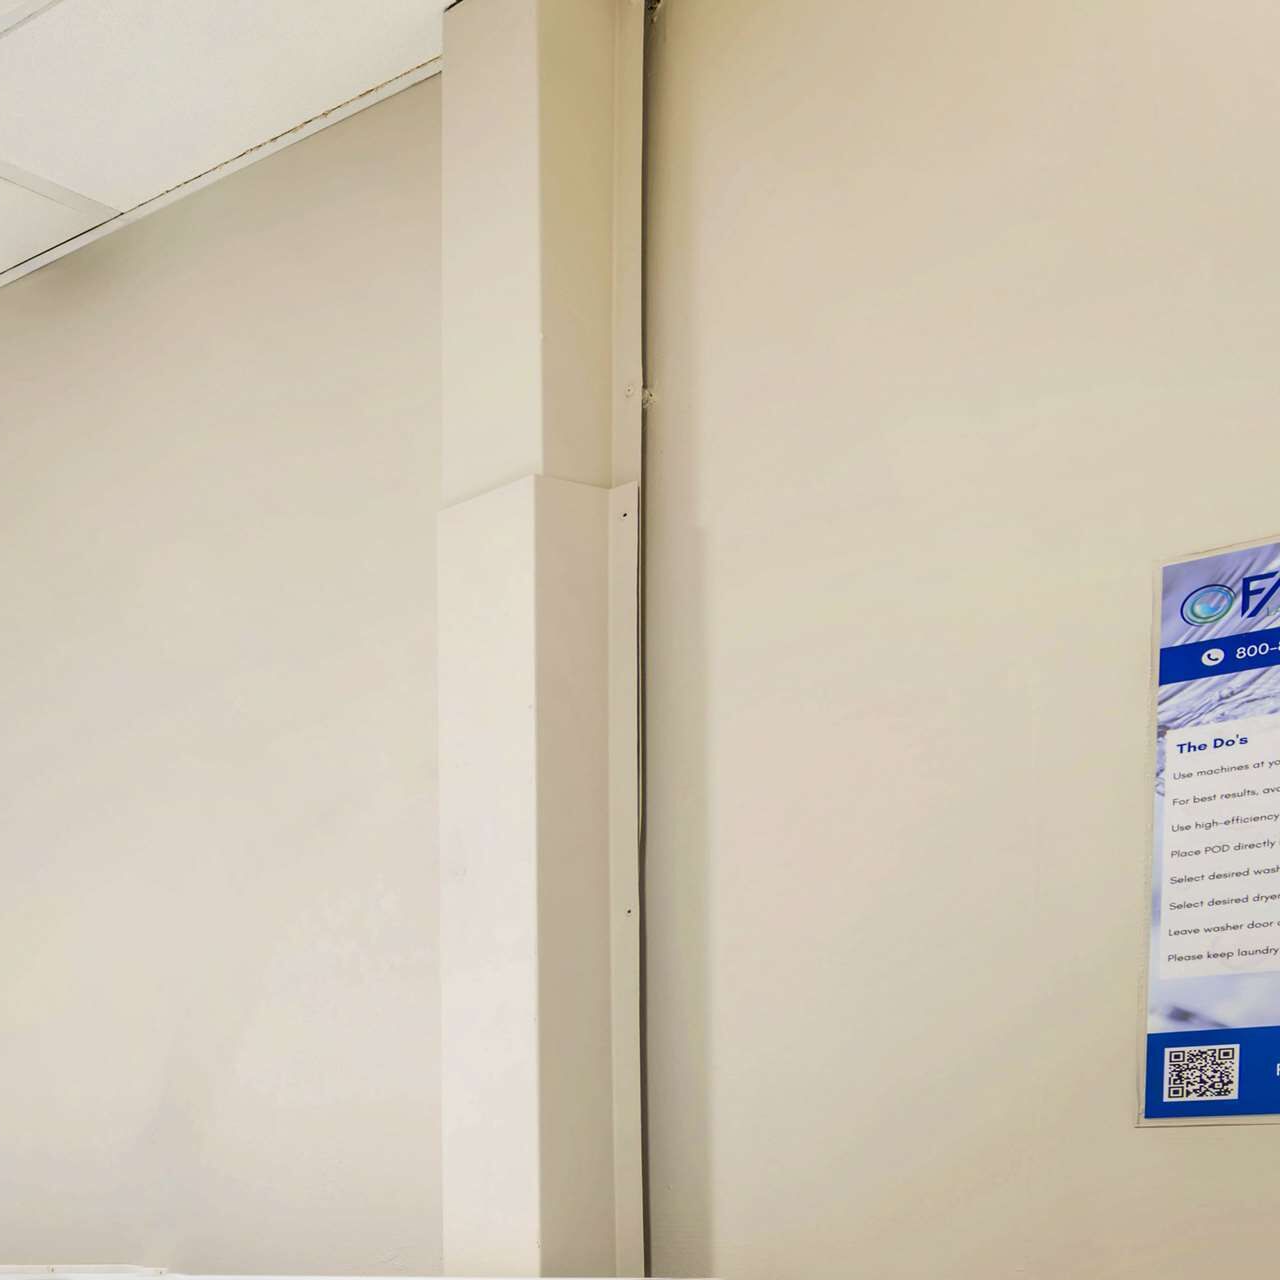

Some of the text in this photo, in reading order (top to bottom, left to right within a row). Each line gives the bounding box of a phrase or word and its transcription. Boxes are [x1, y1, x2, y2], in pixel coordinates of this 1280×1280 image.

[1176, 734, 1248, 754] The Do's
[1173, 771, 1193, 780] Use
[1196, 763, 1249, 776] machines
[1252, 761, 1264, 769] at
[1172, 798, 1190, 806] For
[1193, 794, 1217, 803] best
[1220, 789, 1259, 800] results,
[1171, 813, 1280, 832] Use high-efficiency
[1170, 849, 1201, 858] Place
[1204, 844, 1230, 854] POD
[1233, 839, 1276, 851] directly
[1169, 874, 1205, 885] Select
[1208, 867, 1250, 881] desired
[1169, 900, 1204, 911] Select
[1207, 895, 1249, 907] desired
[1168, 928, 1200, 936] Leave
[1203, 923, 1244, 933] washer
[1247, 920, 1274, 929] door
[1167, 945, 1280, 962] Please keep laundry
